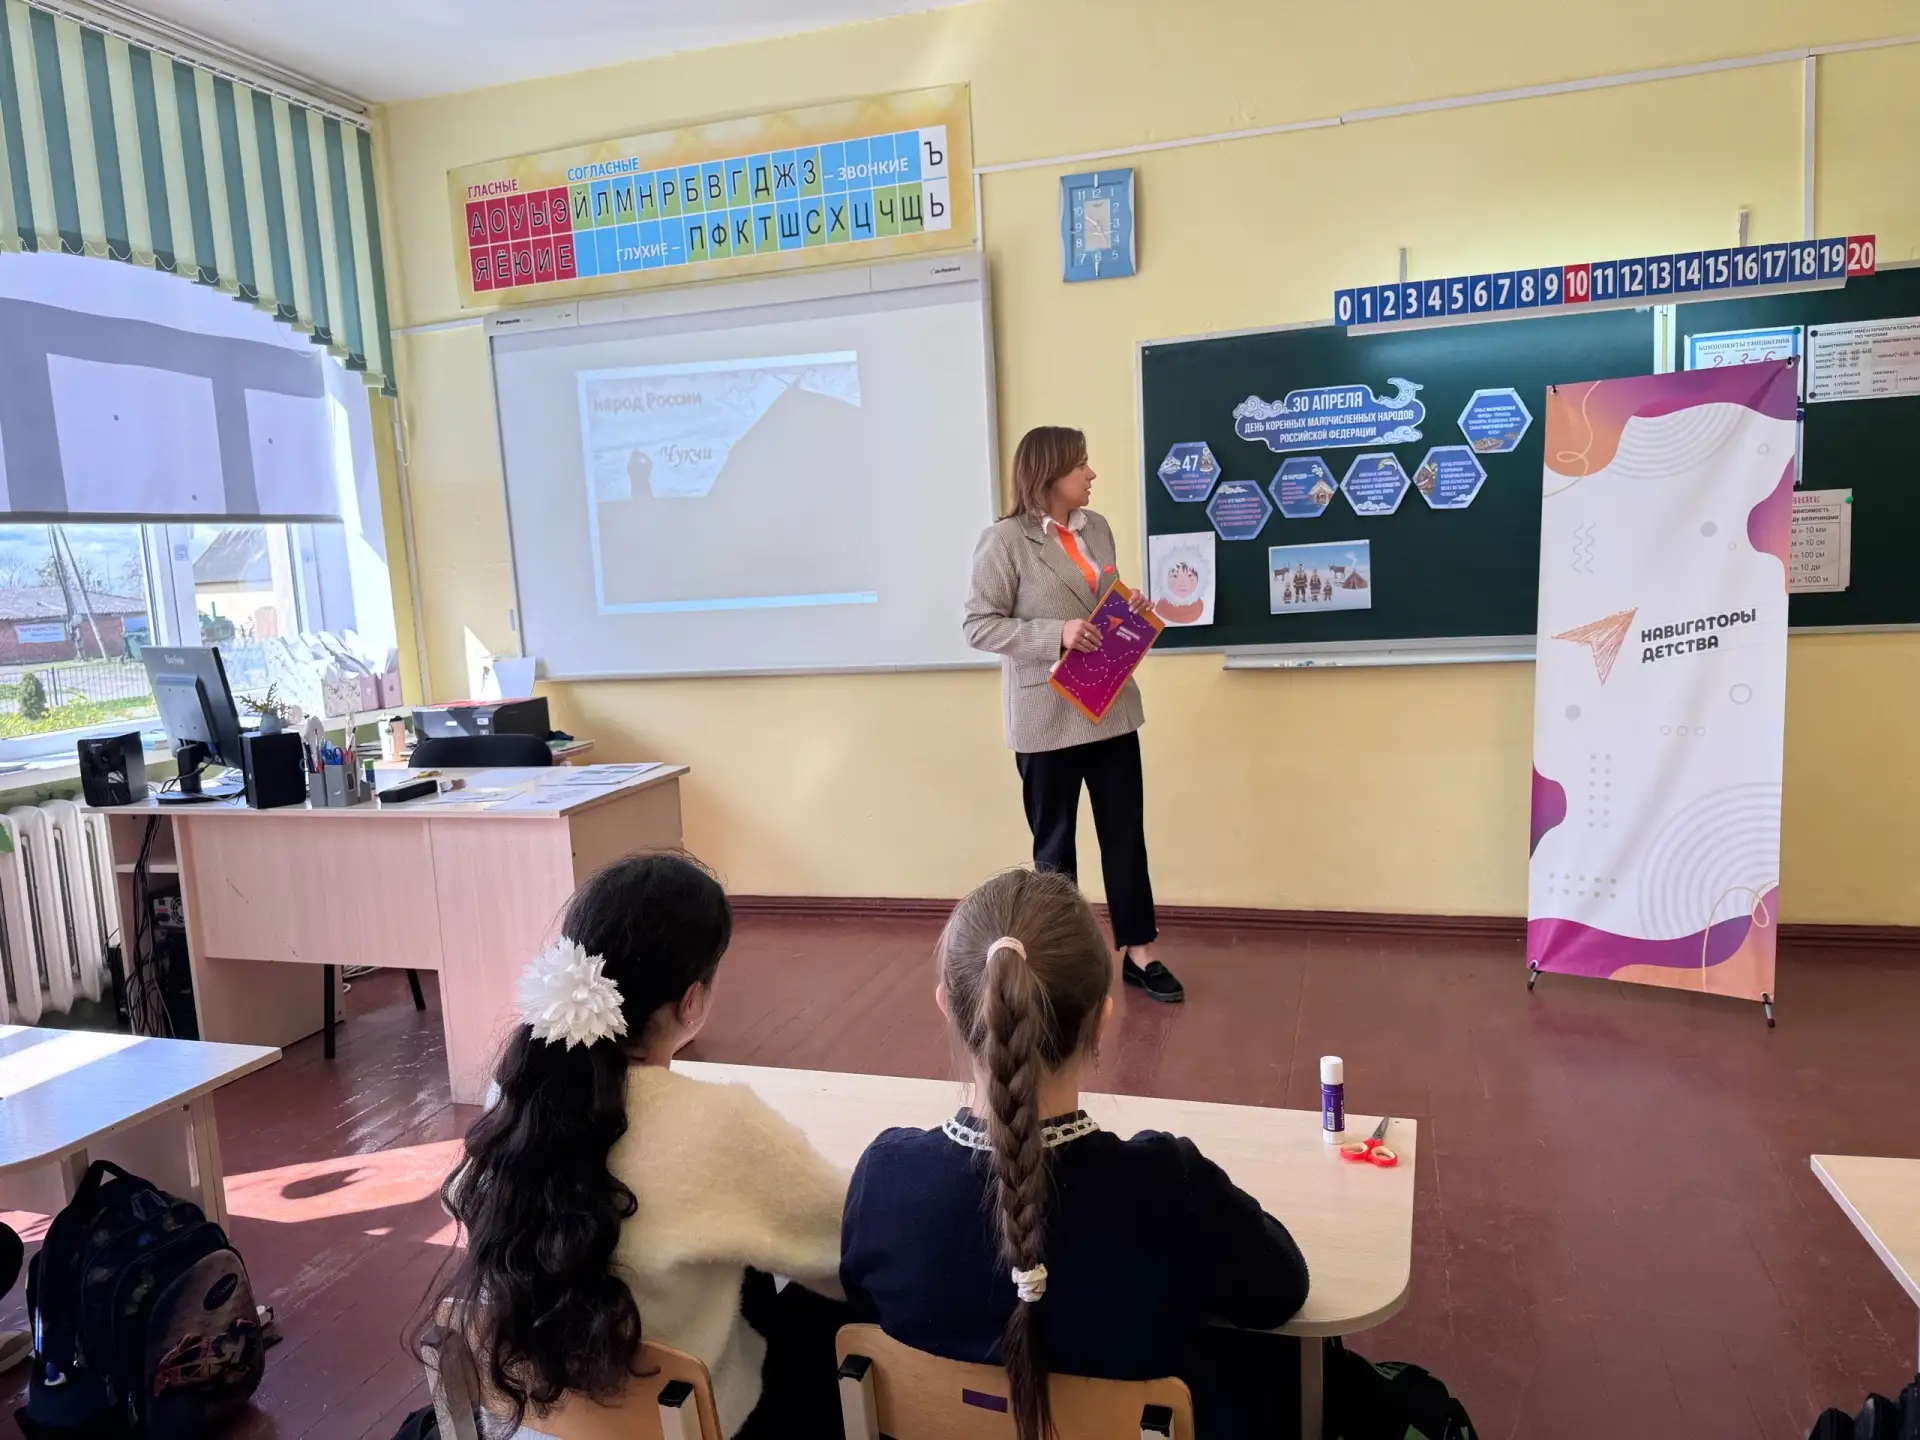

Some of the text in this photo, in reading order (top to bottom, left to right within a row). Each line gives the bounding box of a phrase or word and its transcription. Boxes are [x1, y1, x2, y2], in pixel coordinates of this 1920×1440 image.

[567, 157, 640, 181] СОГЛАСНЫЕ
[468, 179, 519, 198] ГЛАСНЫЕ
[471, 213, 484, 236] А
[491, 209, 505, 232] О
[511, 205, 525, 231] У
[531, 202, 549, 227] Ы
[553, 198, 567, 222] Э
[574, 190, 589, 220] Й
[597, 191, 609, 216] Л
[615, 188, 633, 212] М
[638, 185, 654, 210] Н
[662, 181, 675, 206] Р
[685, 177, 699, 202] Б
[708, 174, 722, 199] В
[731, 170, 743, 195] Г
[754, 167, 770, 198] Д
[774, 162, 796, 189] Ж
[803, 159, 816, 185] З
[837, 157, 909, 181] ЗВОНКИЕ
[924, 141, 943, 166] Ъ
[1092, 189, 1101, 199] 12
[1110, 188, 1114, 197] 1
[1113, 203, 1119, 213] 2
[1075, 223, 1082, 232] 9
[1113, 219, 1120, 228] 3
[476, 258, 490, 281] Я
[497, 251, 509, 278] Ё
[513, 251, 532, 276] Ю
[537, 249, 551, 272] И
[559, 245, 572, 269] Е
[617, 242, 669, 262] ГЛУХИЕ
[689, 225, 705, 251] П
[711, 223, 727, 247] Ф
[736, 219, 749, 245] К
[758, 216, 771, 240] Т
[780, 212, 800, 238] Ш
[806, 209, 821, 235] С
[830, 205, 845, 232] Х
[854, 202, 871, 233] Ц
[879, 198, 894, 224] Ч
[901, 194, 923, 227] Щ
[930, 192, 945, 218] Ь
[1114, 234, 1120, 243] 4
[1075, 239, 1083, 248] 8
[1080, 253, 1086, 264] 7
[1094, 252, 1102, 261] 6
[1112, 250, 1119, 260] 5
[1339, 242, 1874, 321] 0 1 2 3 4 5 6 7 8 9 10 11 12 13 14 15 16 17 18 19 20
[1293, 391, 1363, 413] 30 АПРЕЛЯ
[1244, 410, 1414, 434] ДЕНЬ КОРЕННЫХ МАЛОЧИСЛЕННЫХ НАРОДОВ
[1279, 427, 1377, 444] РОССИЙСКОЙ ФЕДЕРАЦИИ
[1182, 455, 1199, 471] 47
[1801, 551, 1814, 559] 100
[1805, 575, 1821, 583] 1000
[1641, 608, 1756, 643] НАВИГАТОРЫ
[1641, 635, 1719, 663] ДЕТСТВА
